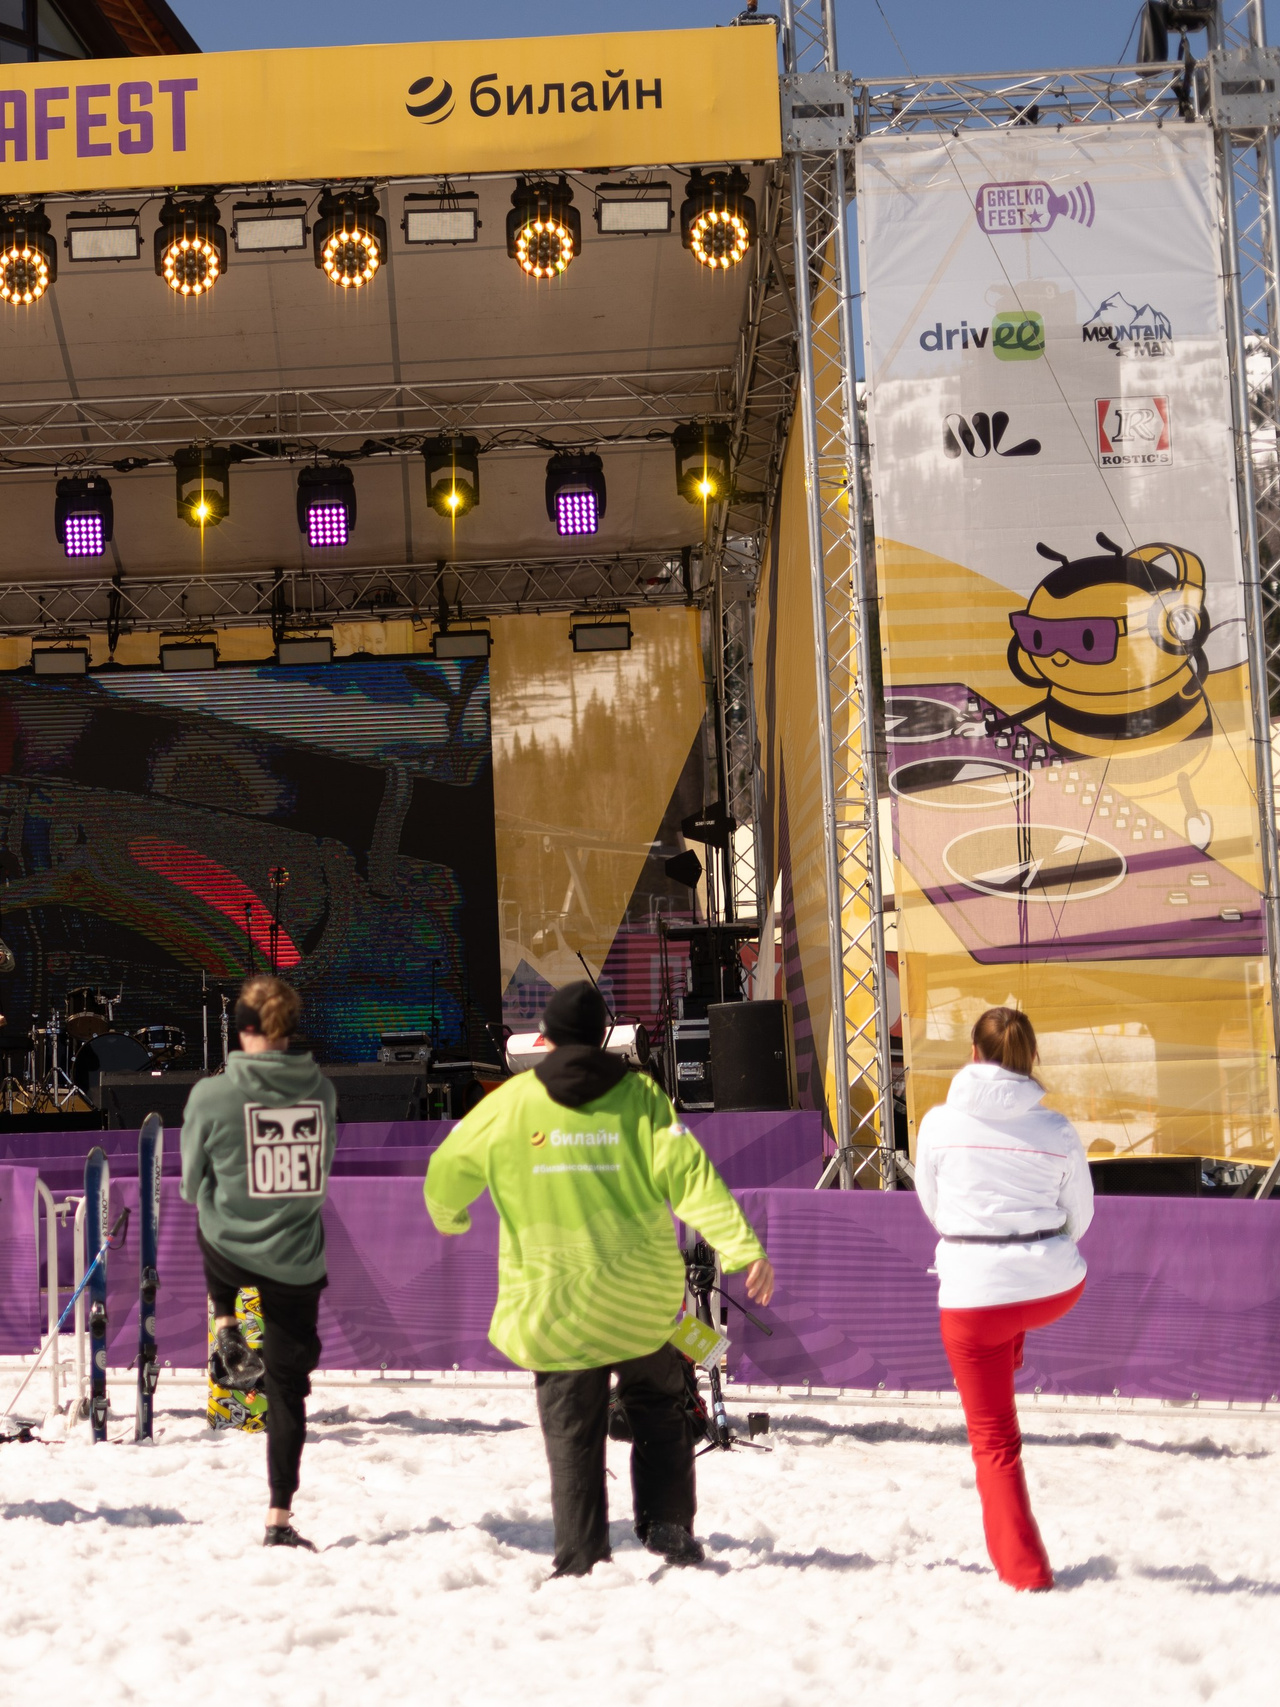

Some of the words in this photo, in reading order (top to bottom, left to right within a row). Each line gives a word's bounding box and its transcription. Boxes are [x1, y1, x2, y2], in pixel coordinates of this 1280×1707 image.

[470, 69, 663, 118] билайн
[987, 187, 1045, 207] GRELKA
[988, 207, 1026, 227] FEST
[919, 318, 1046, 353] drivee
[1082, 324, 1173, 342] MOUNTAIN
[1134, 341, 1176, 358] MAN
[1102, 452, 1170, 466] ROSTIC'S
[549, 1128, 619, 1147] билайн
[254, 1143, 322, 1193] OBEY
